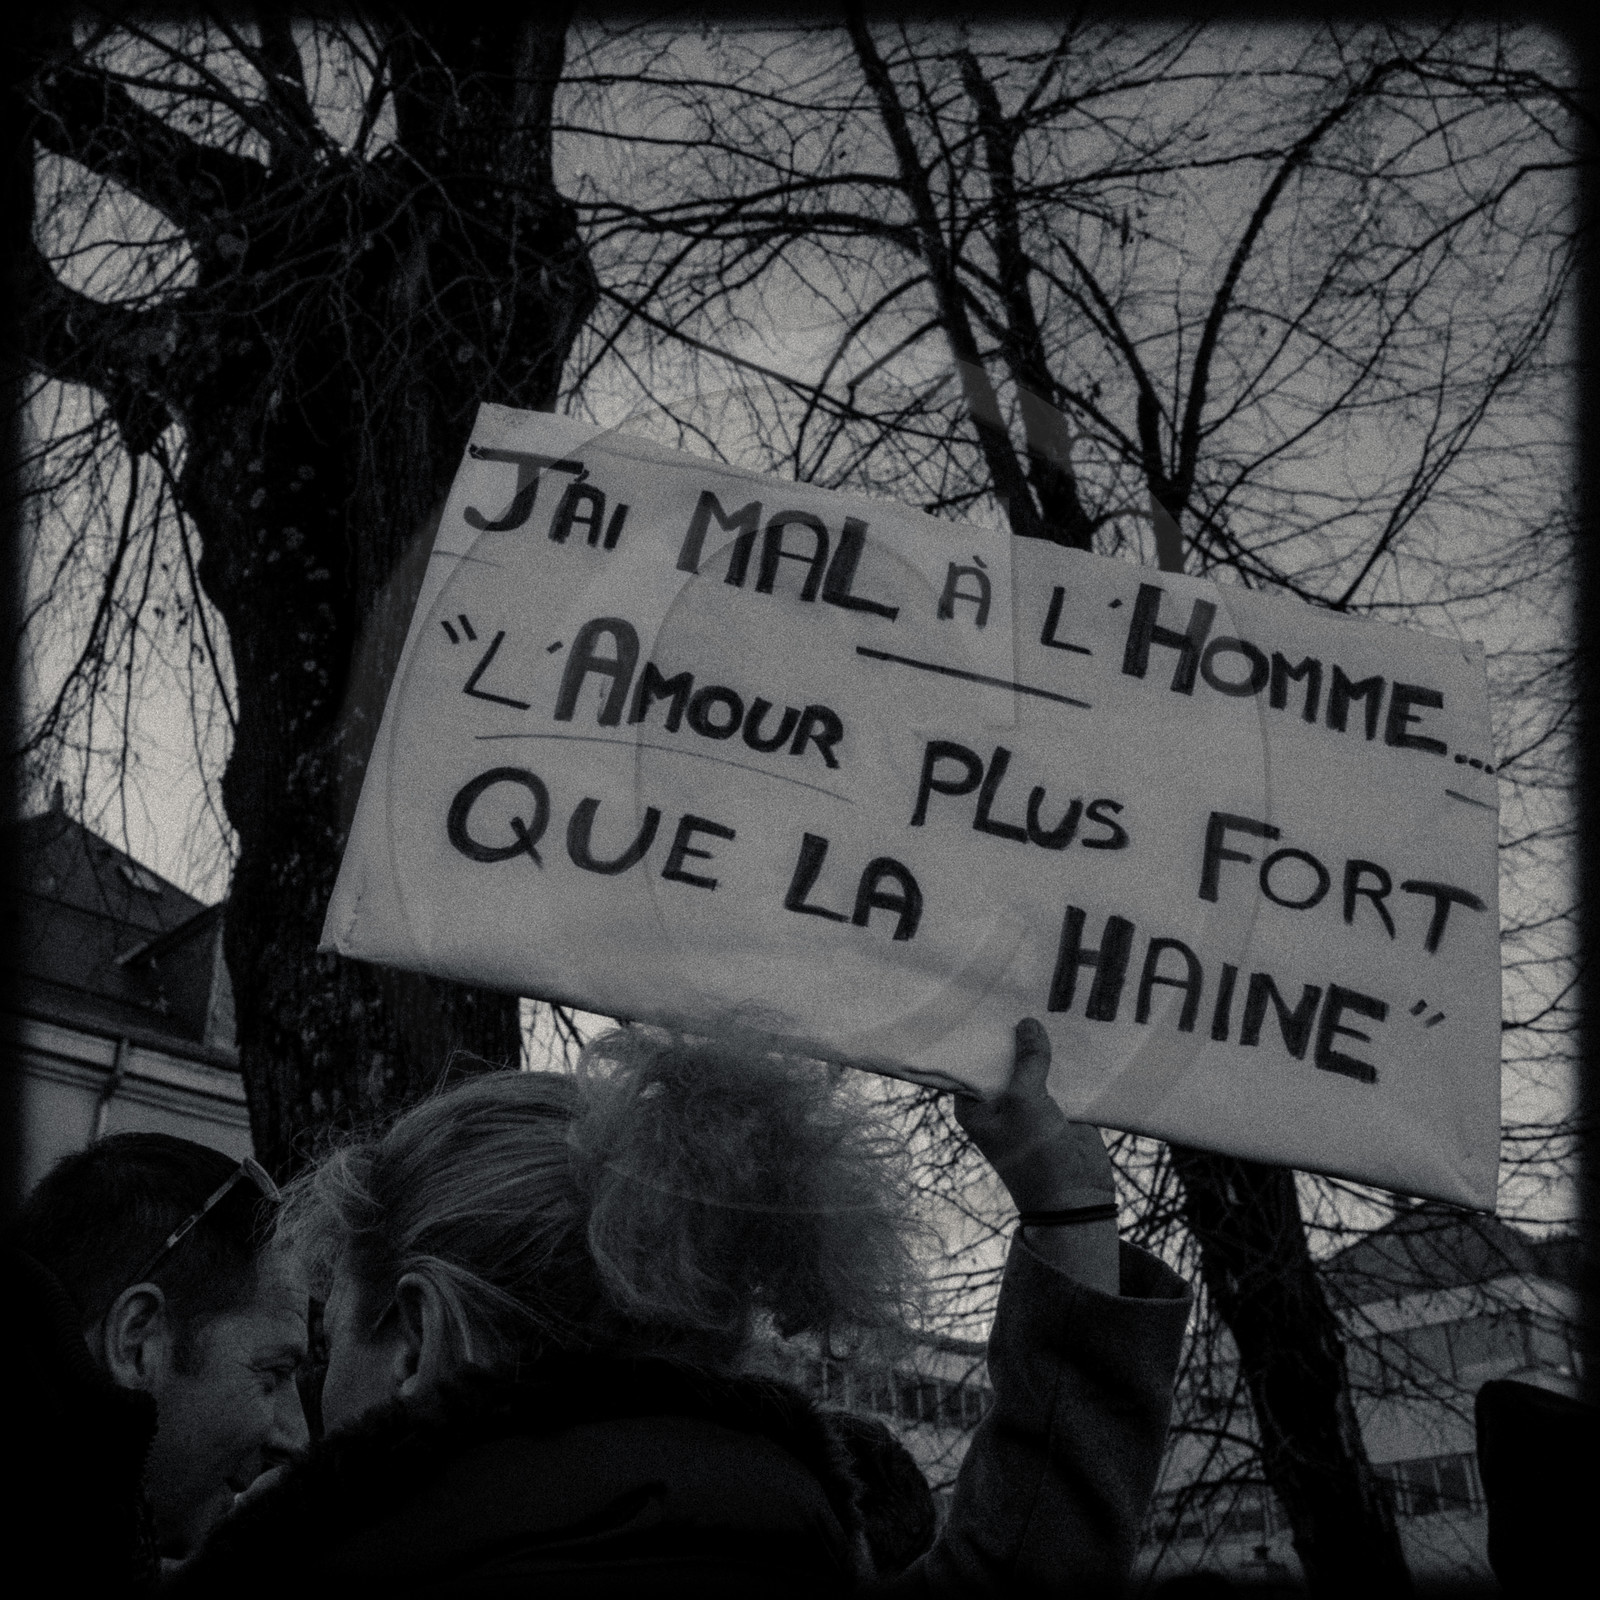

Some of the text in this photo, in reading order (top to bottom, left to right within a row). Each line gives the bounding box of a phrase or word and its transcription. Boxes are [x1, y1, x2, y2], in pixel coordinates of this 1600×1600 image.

[463, 443, 630, 551] J'AI
[676, 489, 899, 622] MAL
[936, 555, 994, 628] À
[446, 765, 736, 892] QUE
[784, 832, 923, 941] LA
[911, 740, 1130, 851] PLUS
[1199, 811, 1488, 953] FORT
